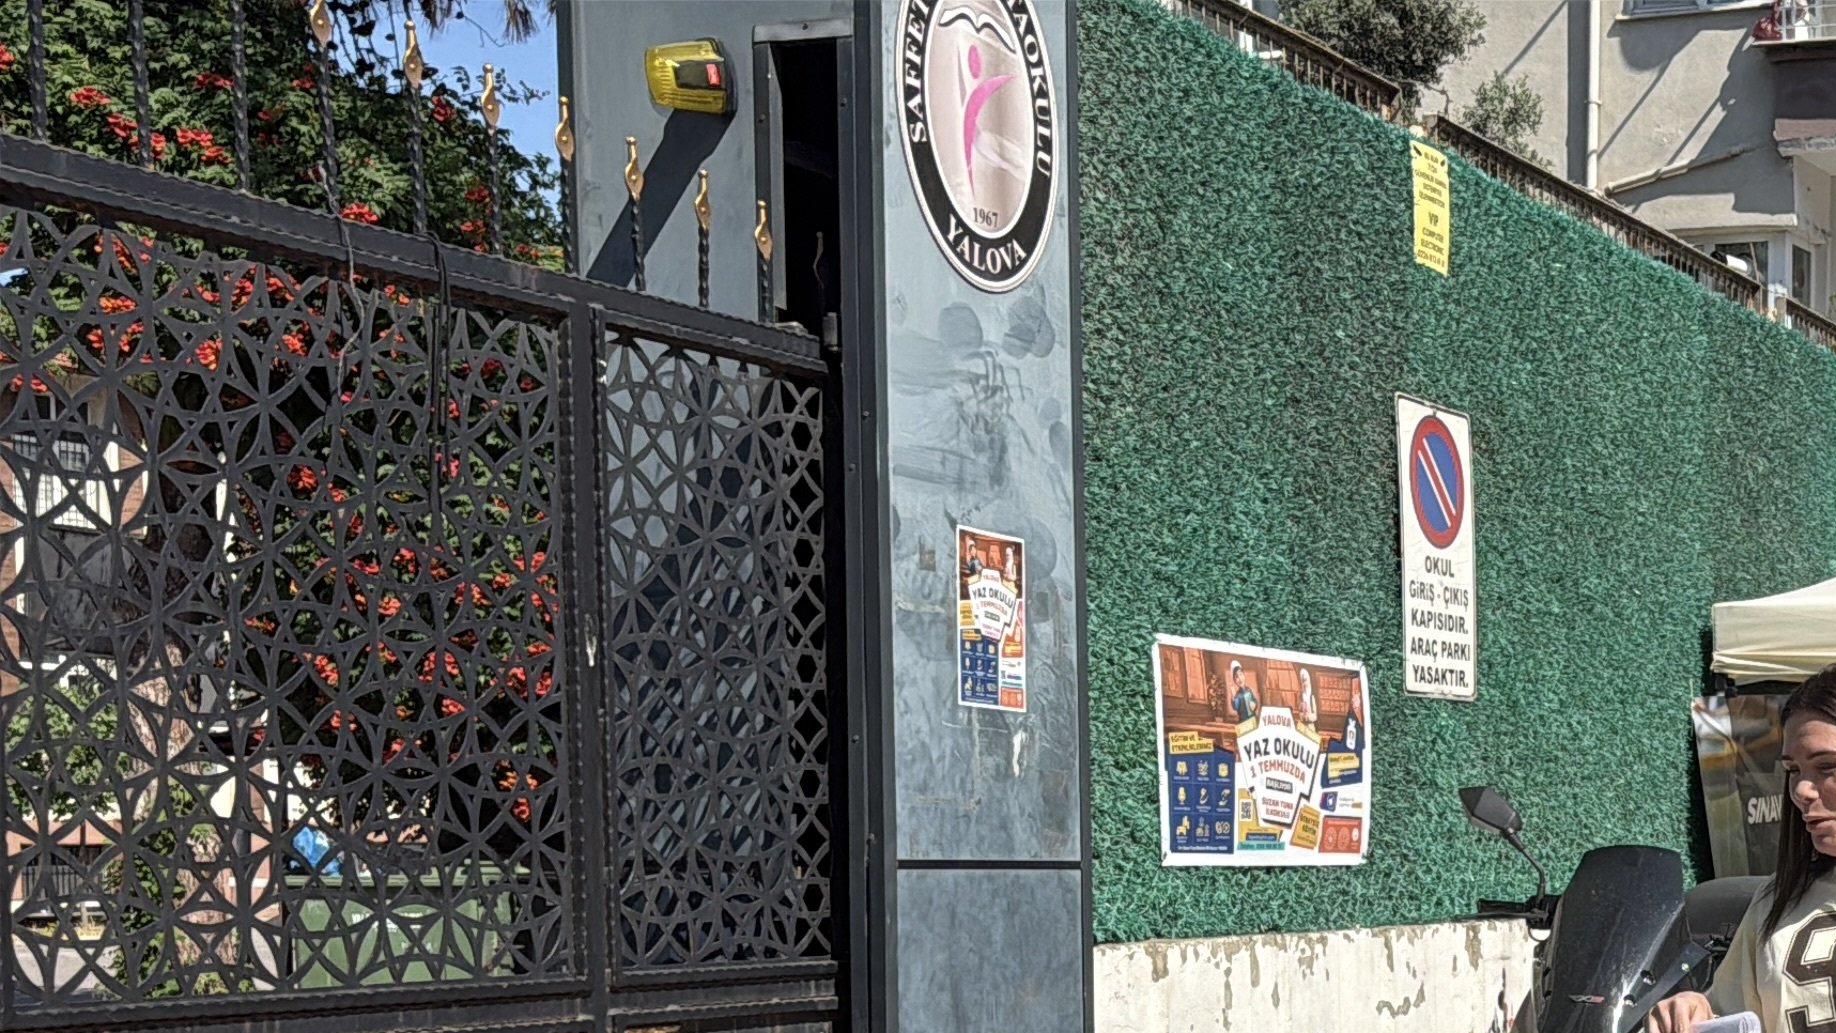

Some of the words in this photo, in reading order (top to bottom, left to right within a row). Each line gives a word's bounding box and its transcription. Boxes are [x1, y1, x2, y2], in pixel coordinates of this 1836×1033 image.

[973, 207, 999, 228] 1967
[946, 213, 1027, 274] YALOVA
[1424, 555, 1455, 578] OKUL
[1443, 586, 1469, 612] ÇIKIŞ
[1411, 607, 1469, 635] KAPISIDIR.
[1410, 636, 1438, 663] ARAÇ
[1412, 664, 1469, 688] YASAKTIR.
[1262, 714, 1292, 728] YALOVA
[1243, 738, 1270, 762] YAZ
[1274, 737, 1315, 769] OKULU
[1258, 759, 1306, 784] TEMMUZDA
